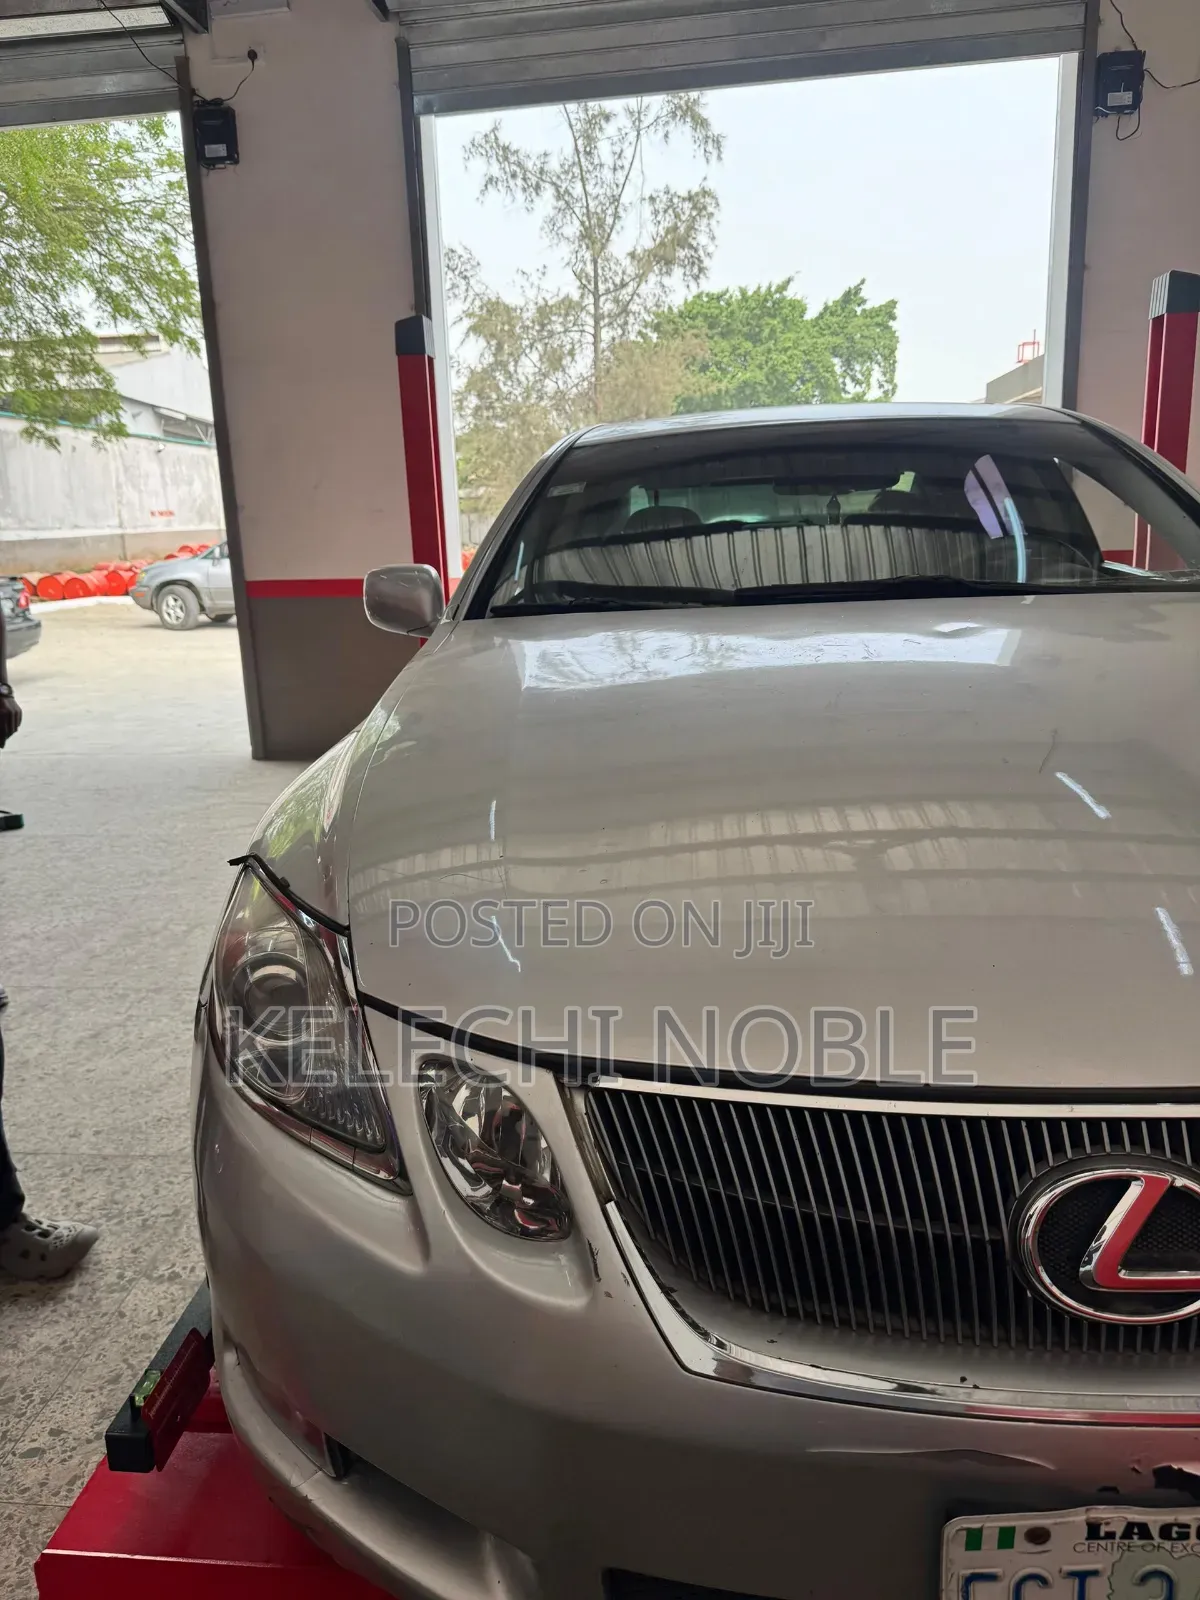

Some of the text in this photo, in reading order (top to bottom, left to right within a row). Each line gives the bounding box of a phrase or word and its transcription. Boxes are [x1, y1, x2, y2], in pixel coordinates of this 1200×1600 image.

[1085, 1519, 1200, 1541] LAG
[1073, 1541, 1137, 1553] CENTRE
[1140, 1541, 1165, 1553] OF
